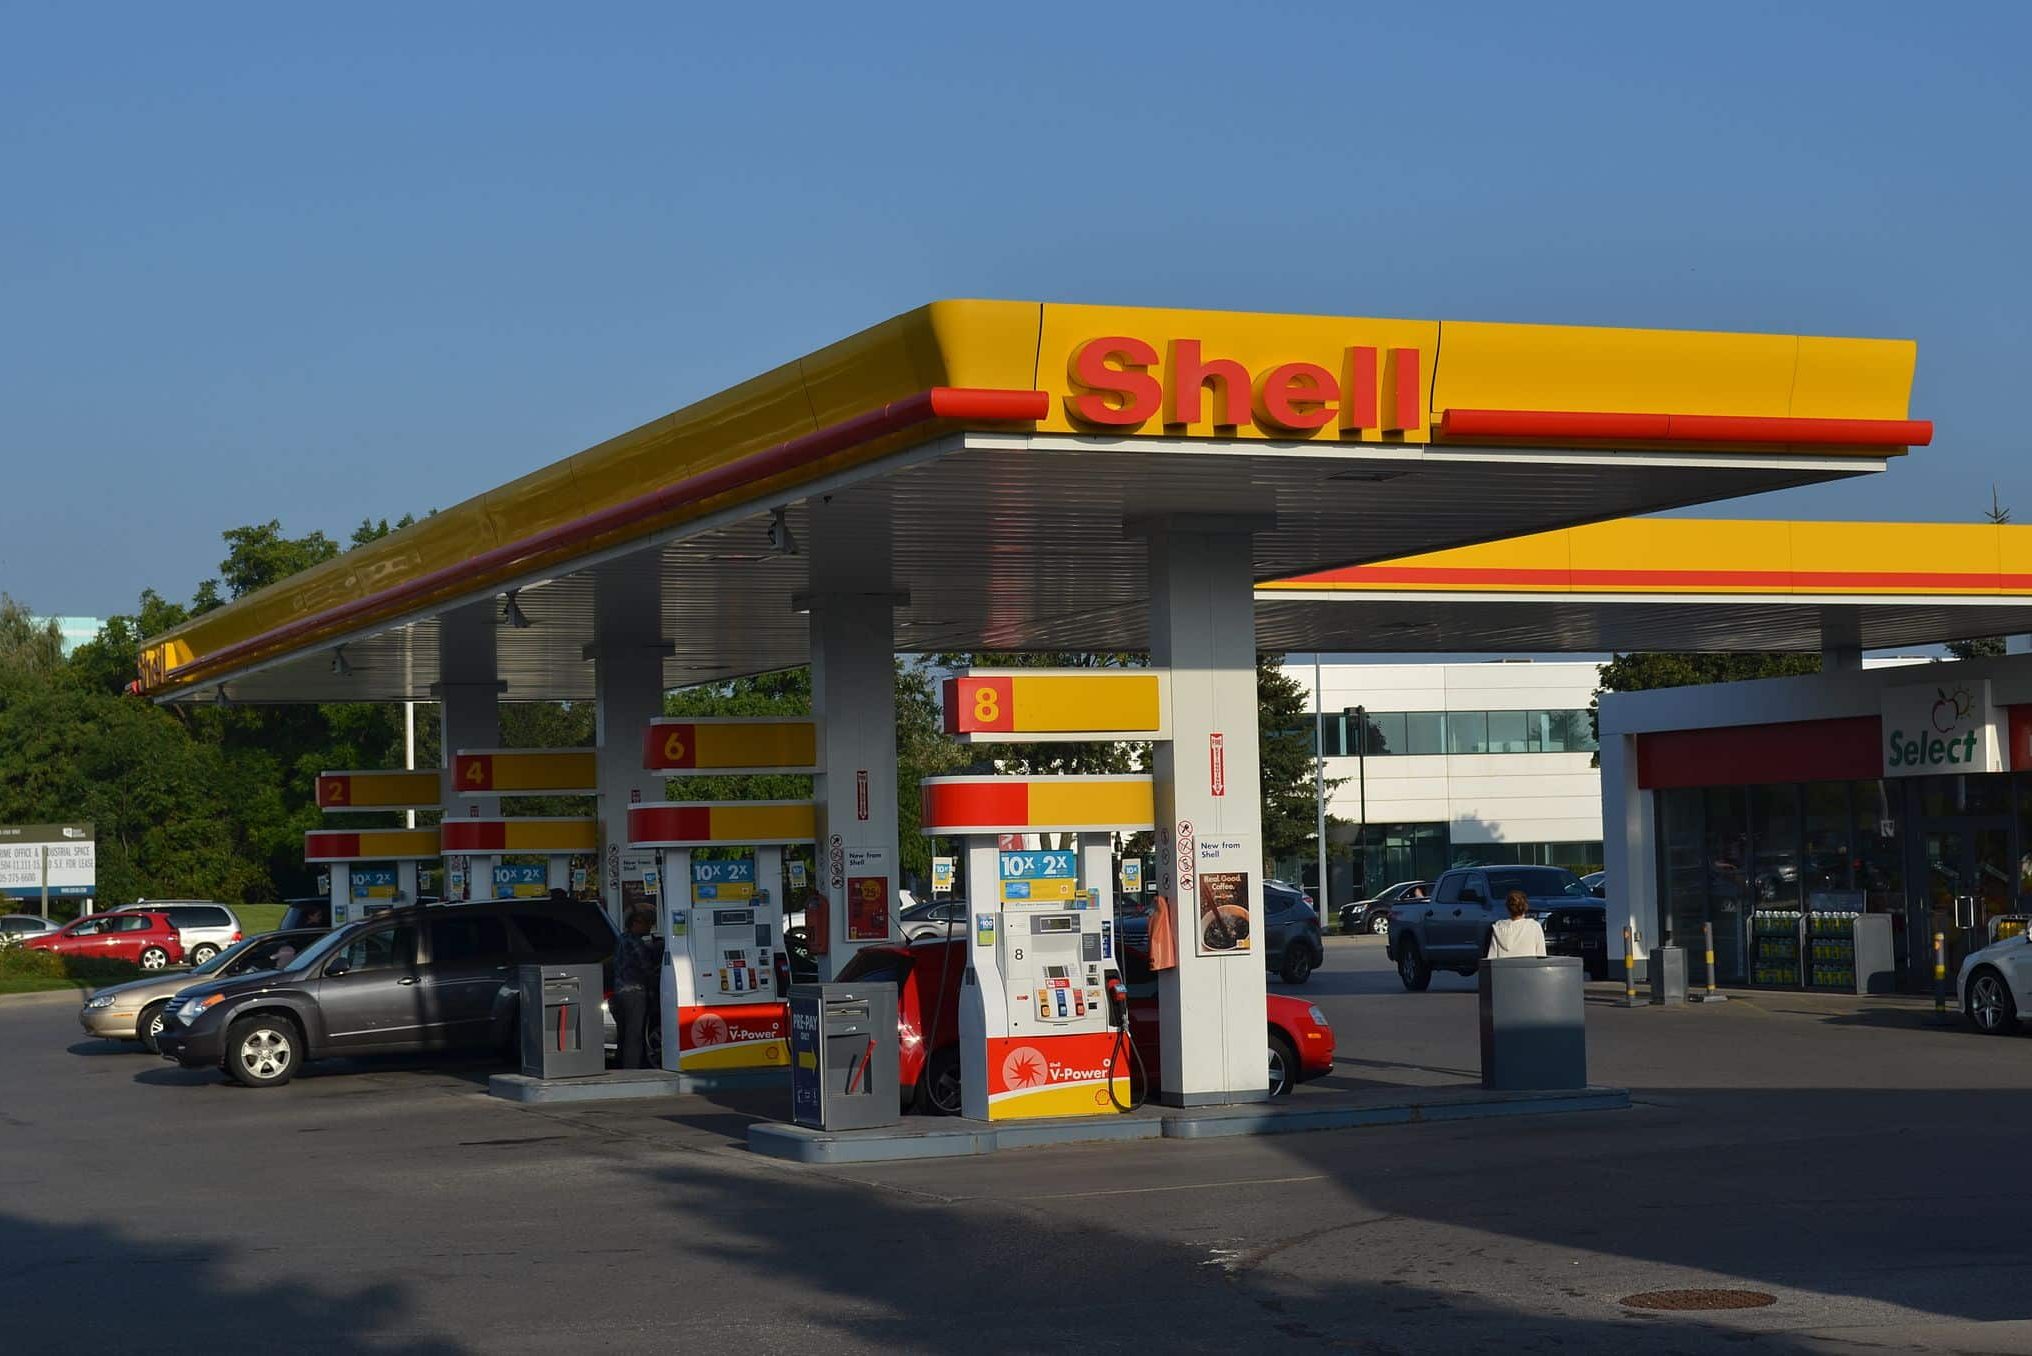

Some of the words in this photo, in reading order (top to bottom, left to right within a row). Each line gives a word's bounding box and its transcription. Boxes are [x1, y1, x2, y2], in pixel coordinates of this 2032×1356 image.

[1062, 336, 1420, 431] Shell
[974, 688, 999, 722] 8
[664, 733, 685, 760] 6
[1888, 730, 1977, 767] Select
[466, 761, 484, 784] 4
[328, 782, 343, 801] 2
[1222, 841, 1241, 849] from
[1014, 948, 1024, 961] 8
[793, 1014, 817, 1032] PRE-PAY
[729, 1029, 777, 1040] V-Power
[1049, 1067, 1108, 1080] V-Power
